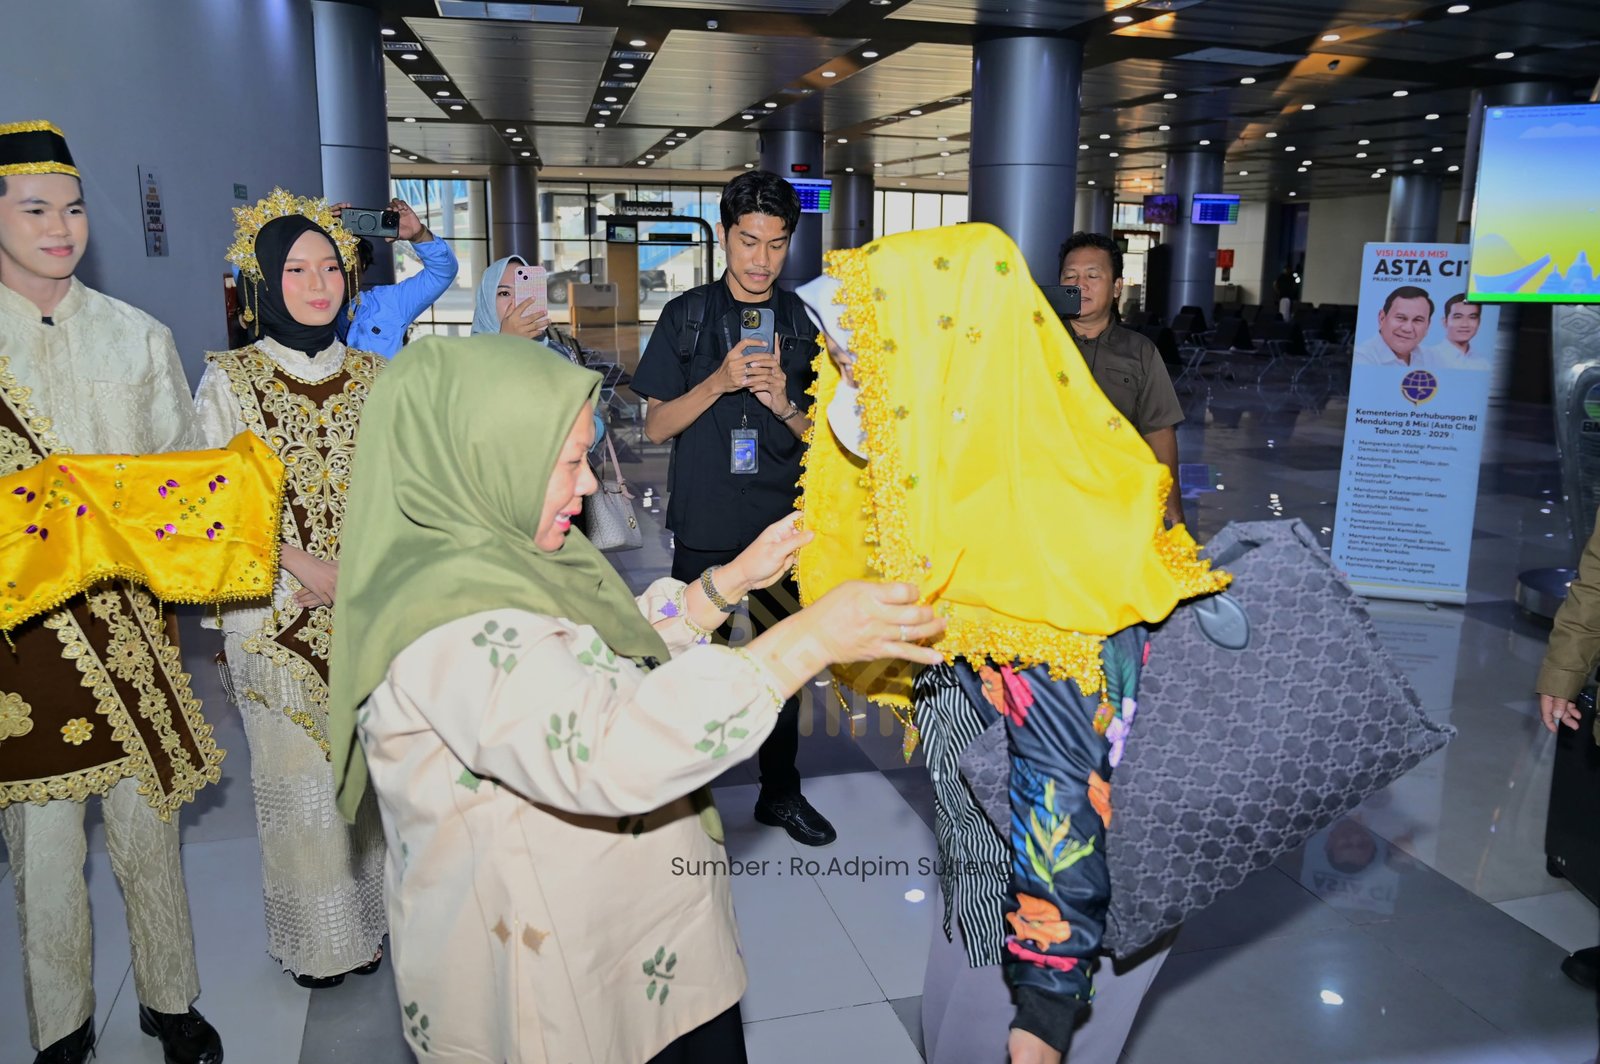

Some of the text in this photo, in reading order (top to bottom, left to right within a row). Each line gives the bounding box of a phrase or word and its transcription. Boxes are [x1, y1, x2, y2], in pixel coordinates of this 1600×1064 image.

[1376, 249, 1394, 257] VISI
[1396, 249, 1417, 258] DAN
[1374, 259, 1469, 277] ASTA CI
[1356, 408, 1478, 422] Kementerian Perhubungan RI
[1355, 417, 1403, 428] Mendukung
[1431, 421, 1453, 430] (Asta
[1455, 423, 1477, 432] Cita)
[1375, 427, 1399, 436] Tahun
[1401, 428, 1421, 436] 2025
[1429, 430, 1449, 438] 2029
